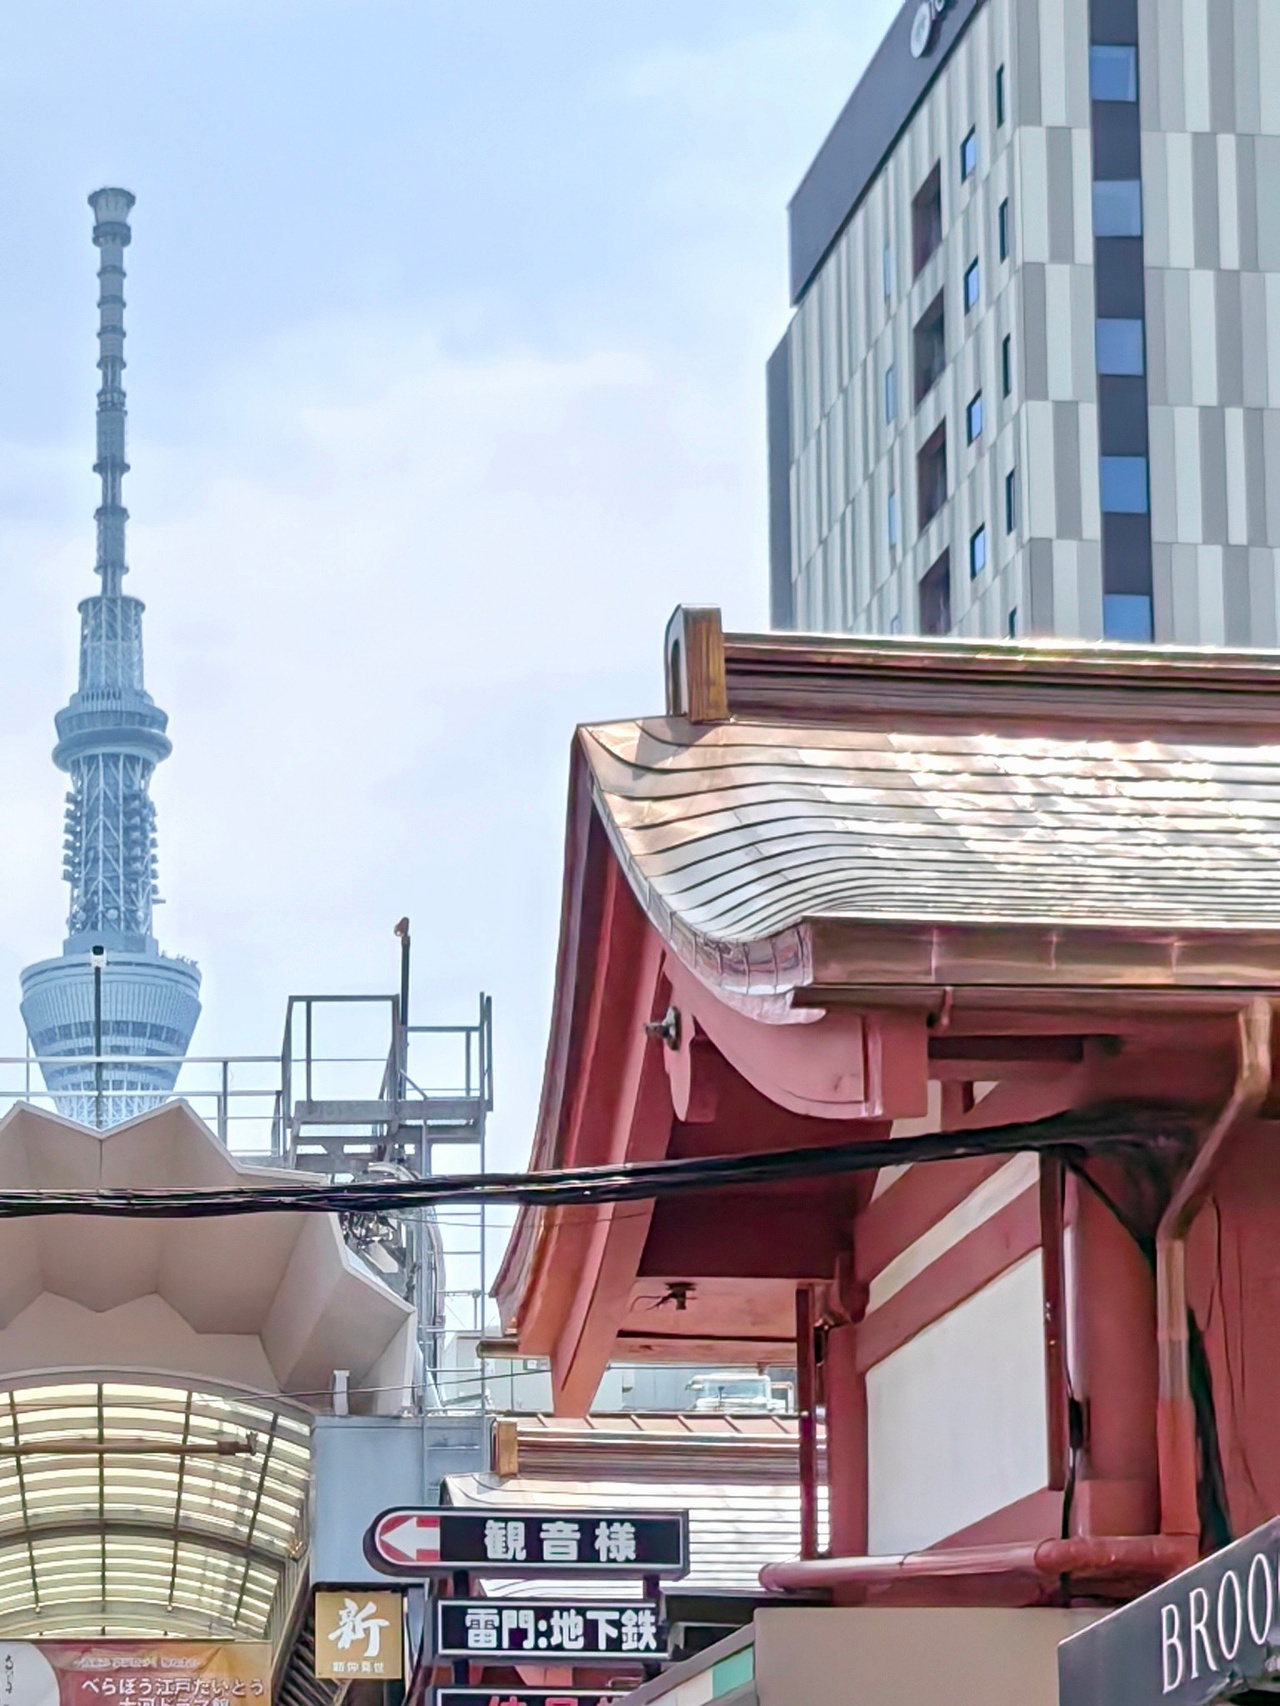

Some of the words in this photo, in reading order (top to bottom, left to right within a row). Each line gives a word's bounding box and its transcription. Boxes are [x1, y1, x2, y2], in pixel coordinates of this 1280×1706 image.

[484, 1520, 636, 1562] 観音様
[327, 1597, 390, 1657] 新
[465, 1609, 657, 1650] 雷門:地下鉄
[1161, 1553, 1280, 1695] BROO
[81, 1676, 265, 1697] べらぼう江戸たいとう
